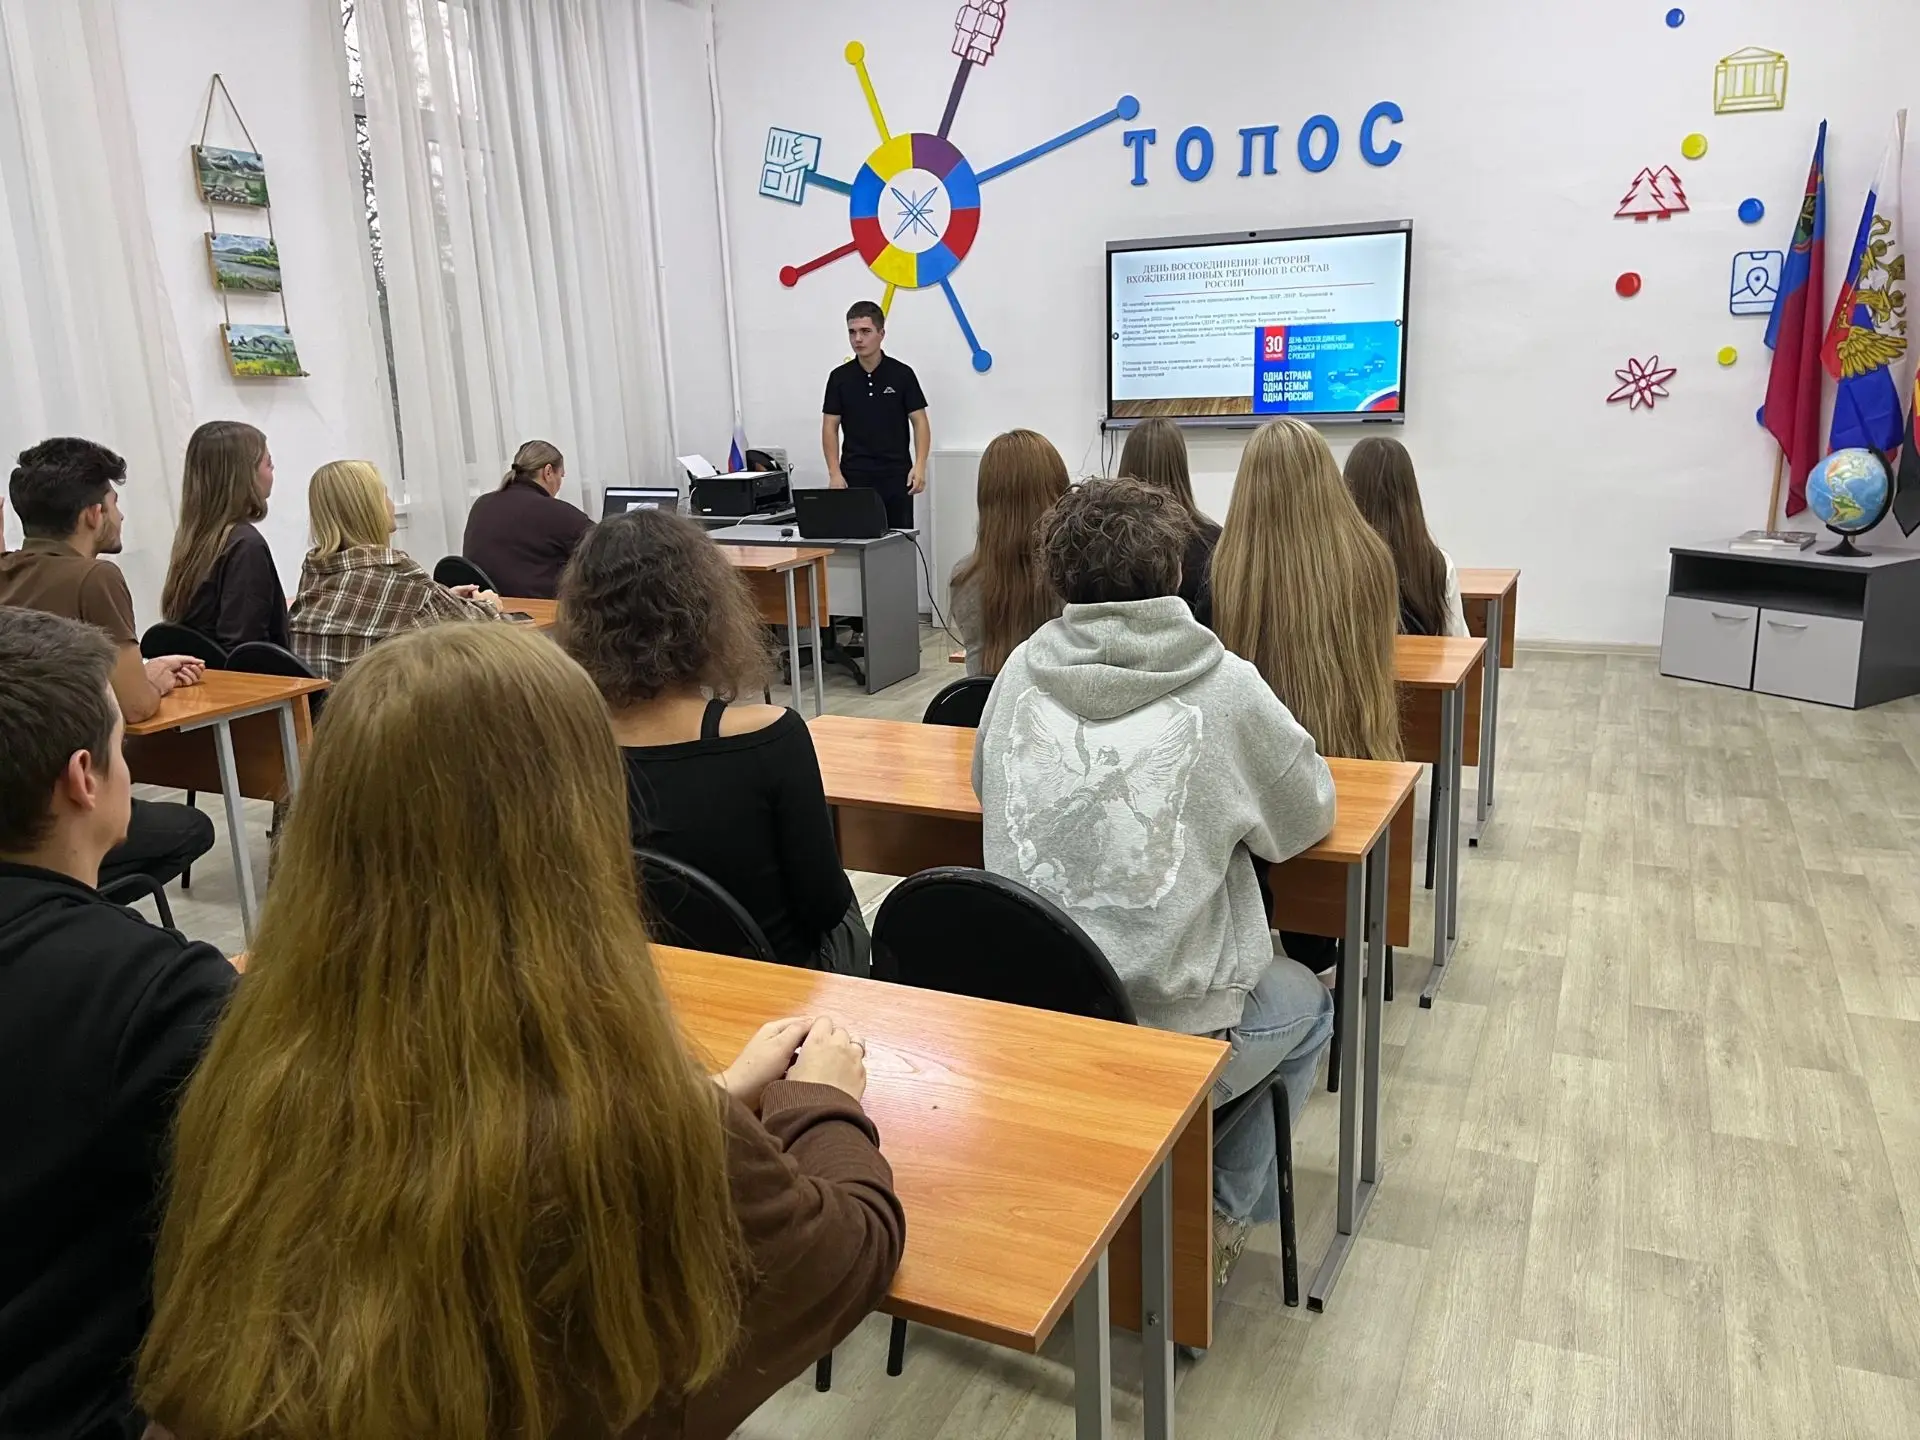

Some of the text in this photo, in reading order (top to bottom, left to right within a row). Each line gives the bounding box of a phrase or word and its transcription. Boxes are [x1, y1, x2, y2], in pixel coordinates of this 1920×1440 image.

[1123, 101, 1404, 186] ТОПОС
[1143, 264, 1169, 274] ДЕНЬ
[1263, 255, 1310, 266] ИСТОРИЯ
[1126, 263, 1330, 284] ВХОЖДЕНИЯ НОВЫХ РЕГИОНОВ В СОСТАВ
[1205, 278, 1244, 289] РОССИИ
[1265, 336, 1284, 353] 30
[1288, 336, 1302, 345] ДЕНЬ
[1288, 344, 1315, 353] ДОНБАССА
[1263, 371, 1312, 383] ОДНА СТРАНА
[1263, 381, 1309, 392] ОДНА СЕМЬЯ
[1262, 391, 1313, 402] ОДНА РОССИЯ!
